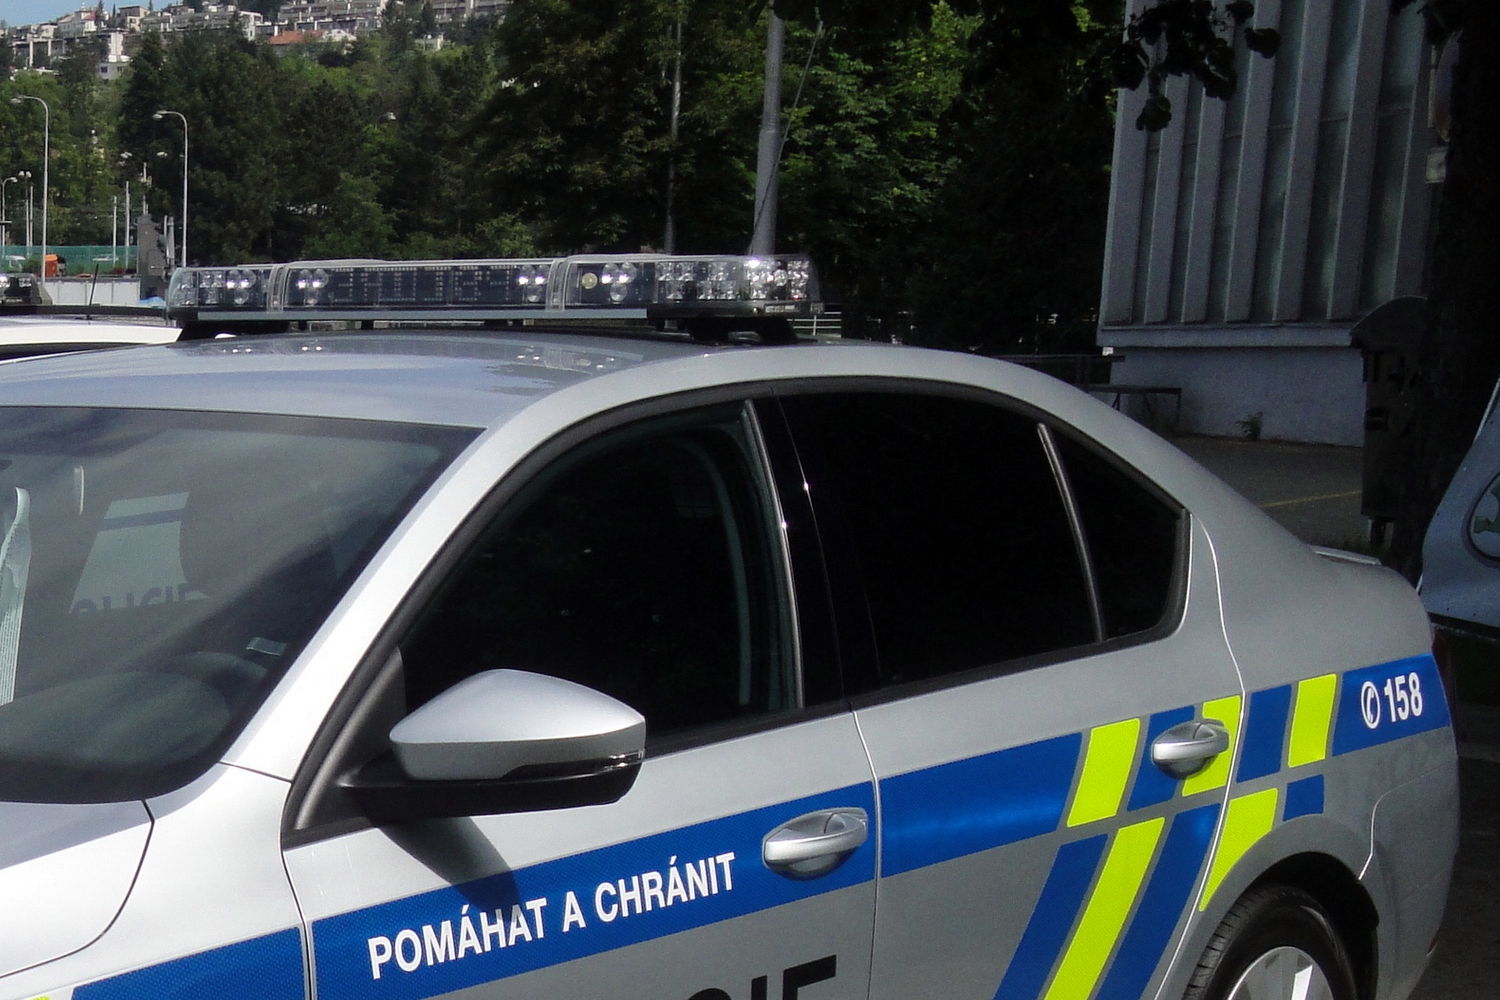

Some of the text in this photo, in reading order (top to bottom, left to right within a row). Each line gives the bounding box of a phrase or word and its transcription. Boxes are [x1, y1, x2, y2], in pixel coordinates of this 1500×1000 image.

[1384, 672, 1423, 723] 158
[368, 852, 737, 980] POMÁHAT A CHRÁNIT
